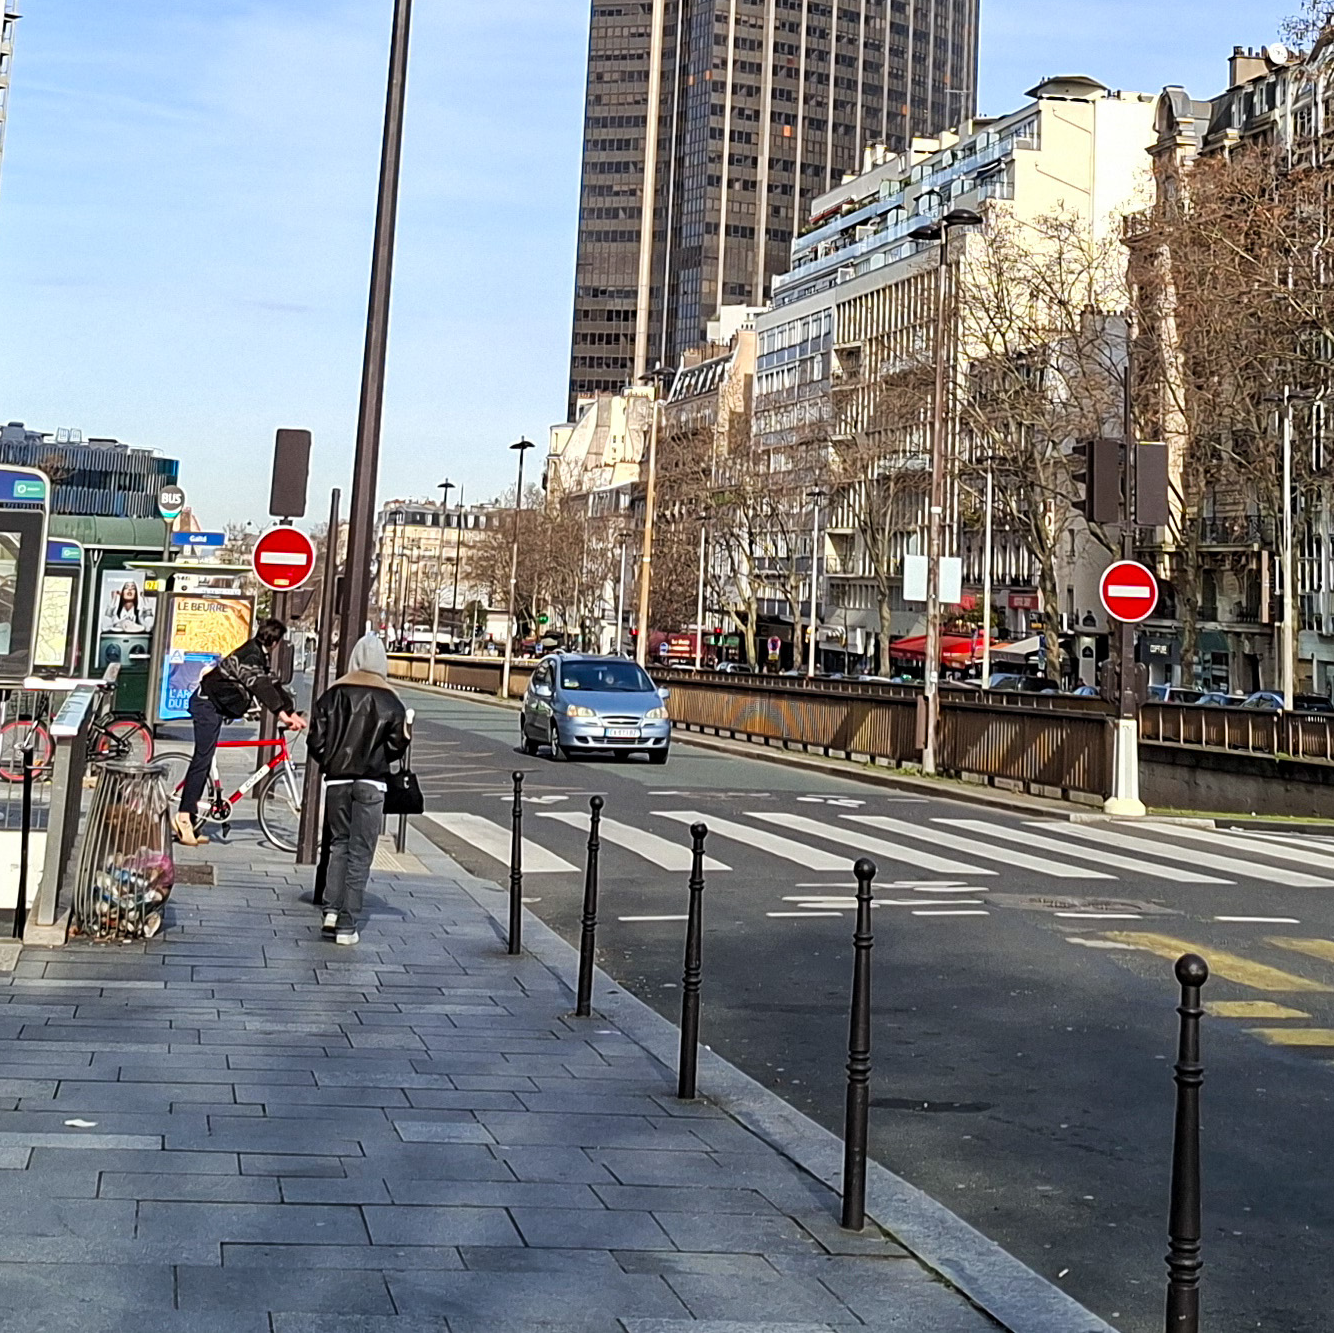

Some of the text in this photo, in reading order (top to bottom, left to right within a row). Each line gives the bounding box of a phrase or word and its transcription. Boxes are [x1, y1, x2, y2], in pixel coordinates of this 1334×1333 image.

[161, 492, 182, 505] BUS
[177, 601, 228, 613] LE BEURRE
